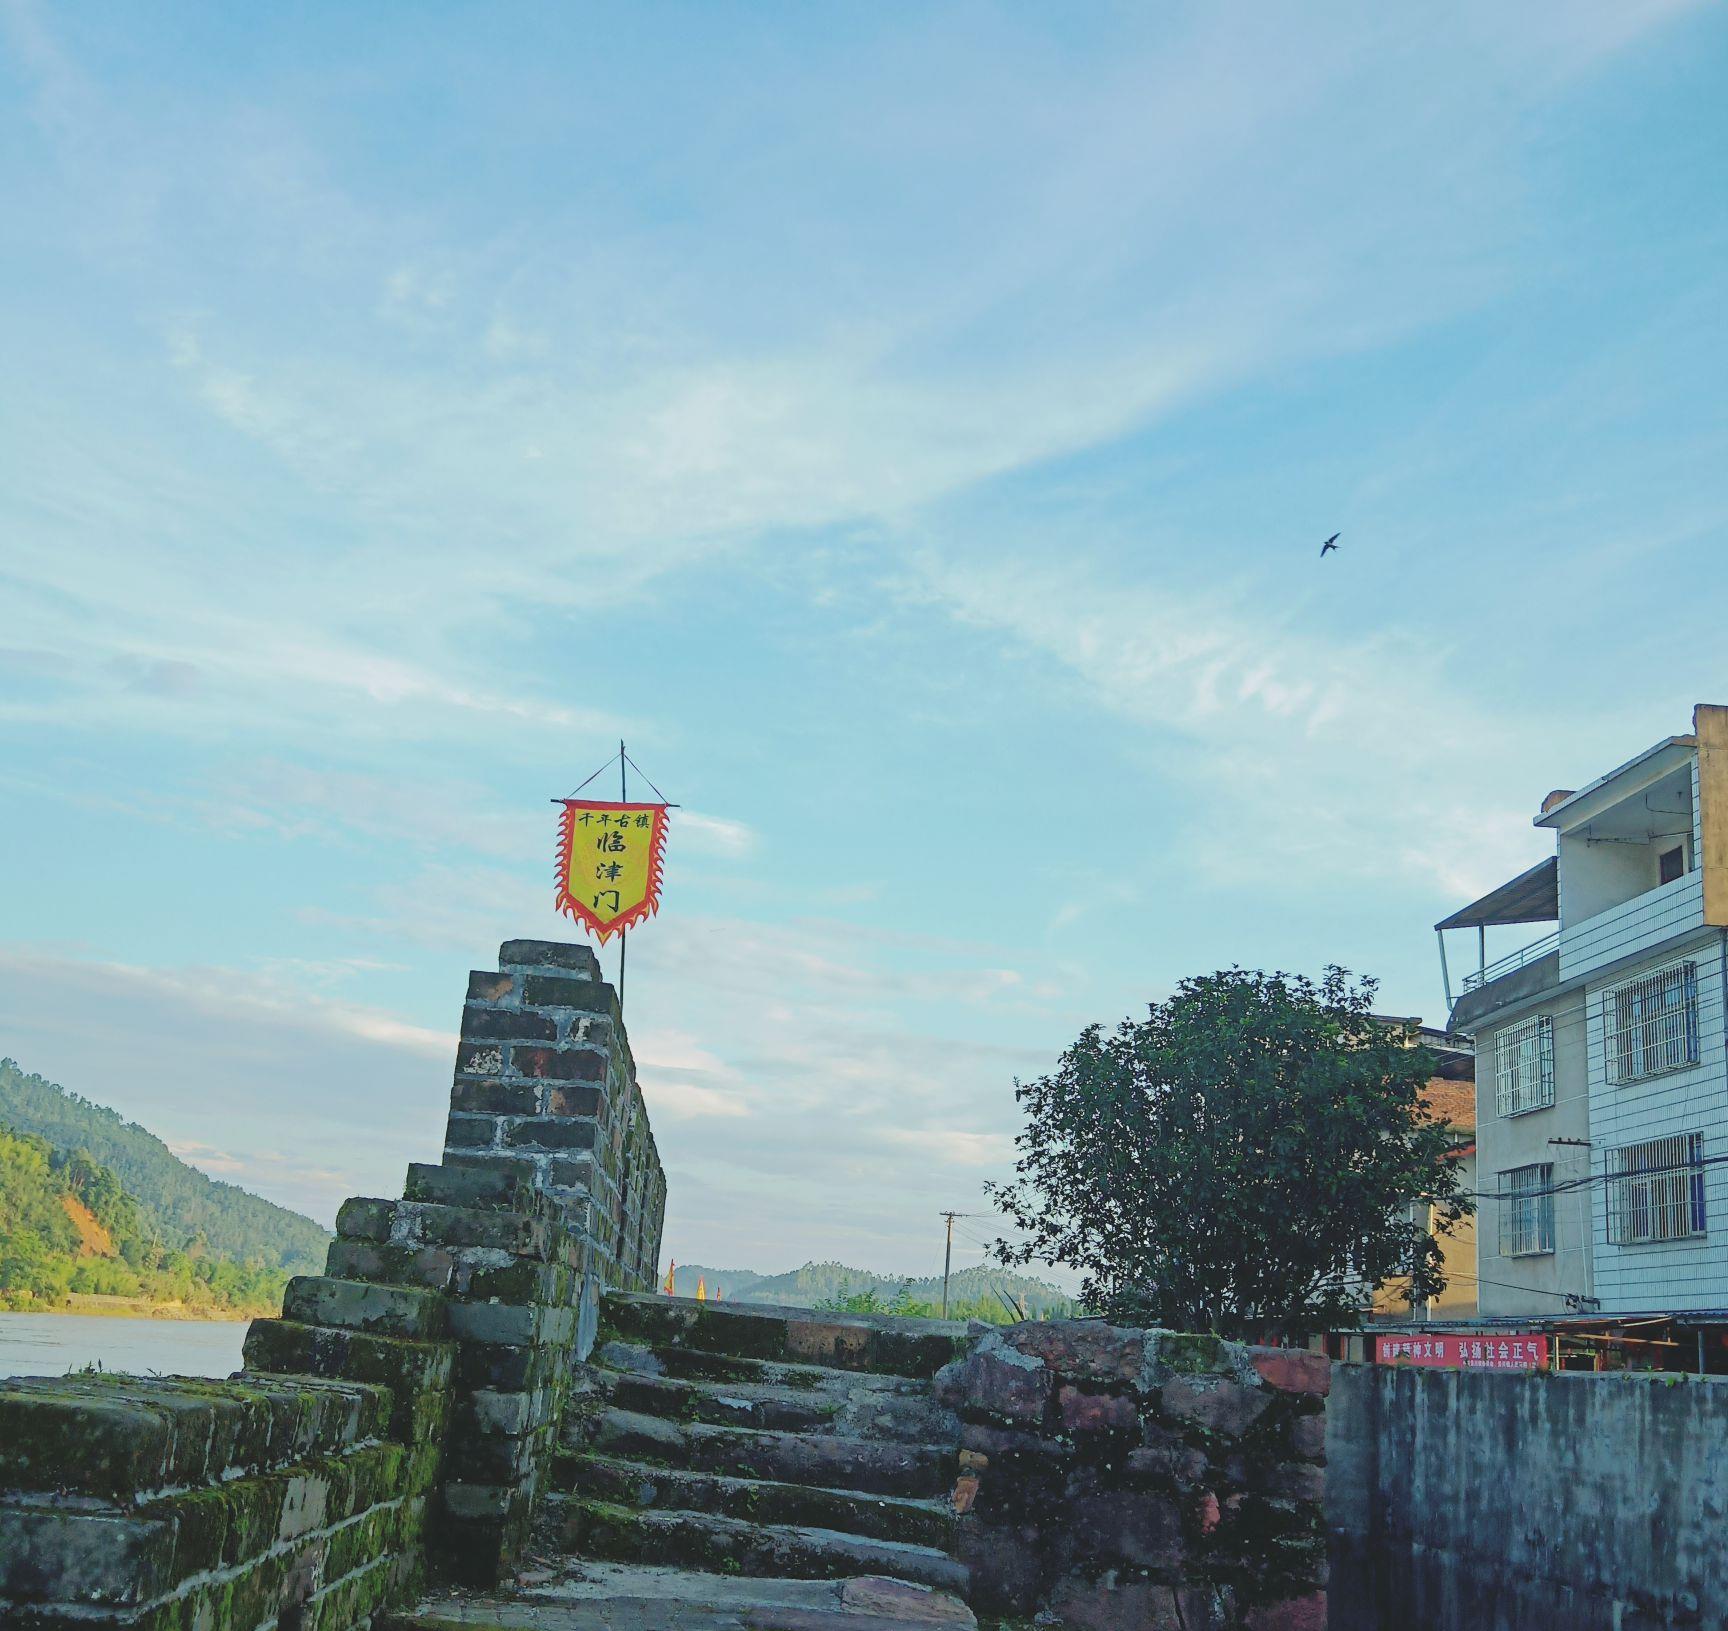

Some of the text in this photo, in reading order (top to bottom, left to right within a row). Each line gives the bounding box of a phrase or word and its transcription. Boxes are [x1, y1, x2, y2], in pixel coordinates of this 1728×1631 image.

[578, 812, 650, 828] 千年古镇
[593, 830, 627, 913] 临津门
[1459, 1341, 1539, 1361] 弘扬社会正气
